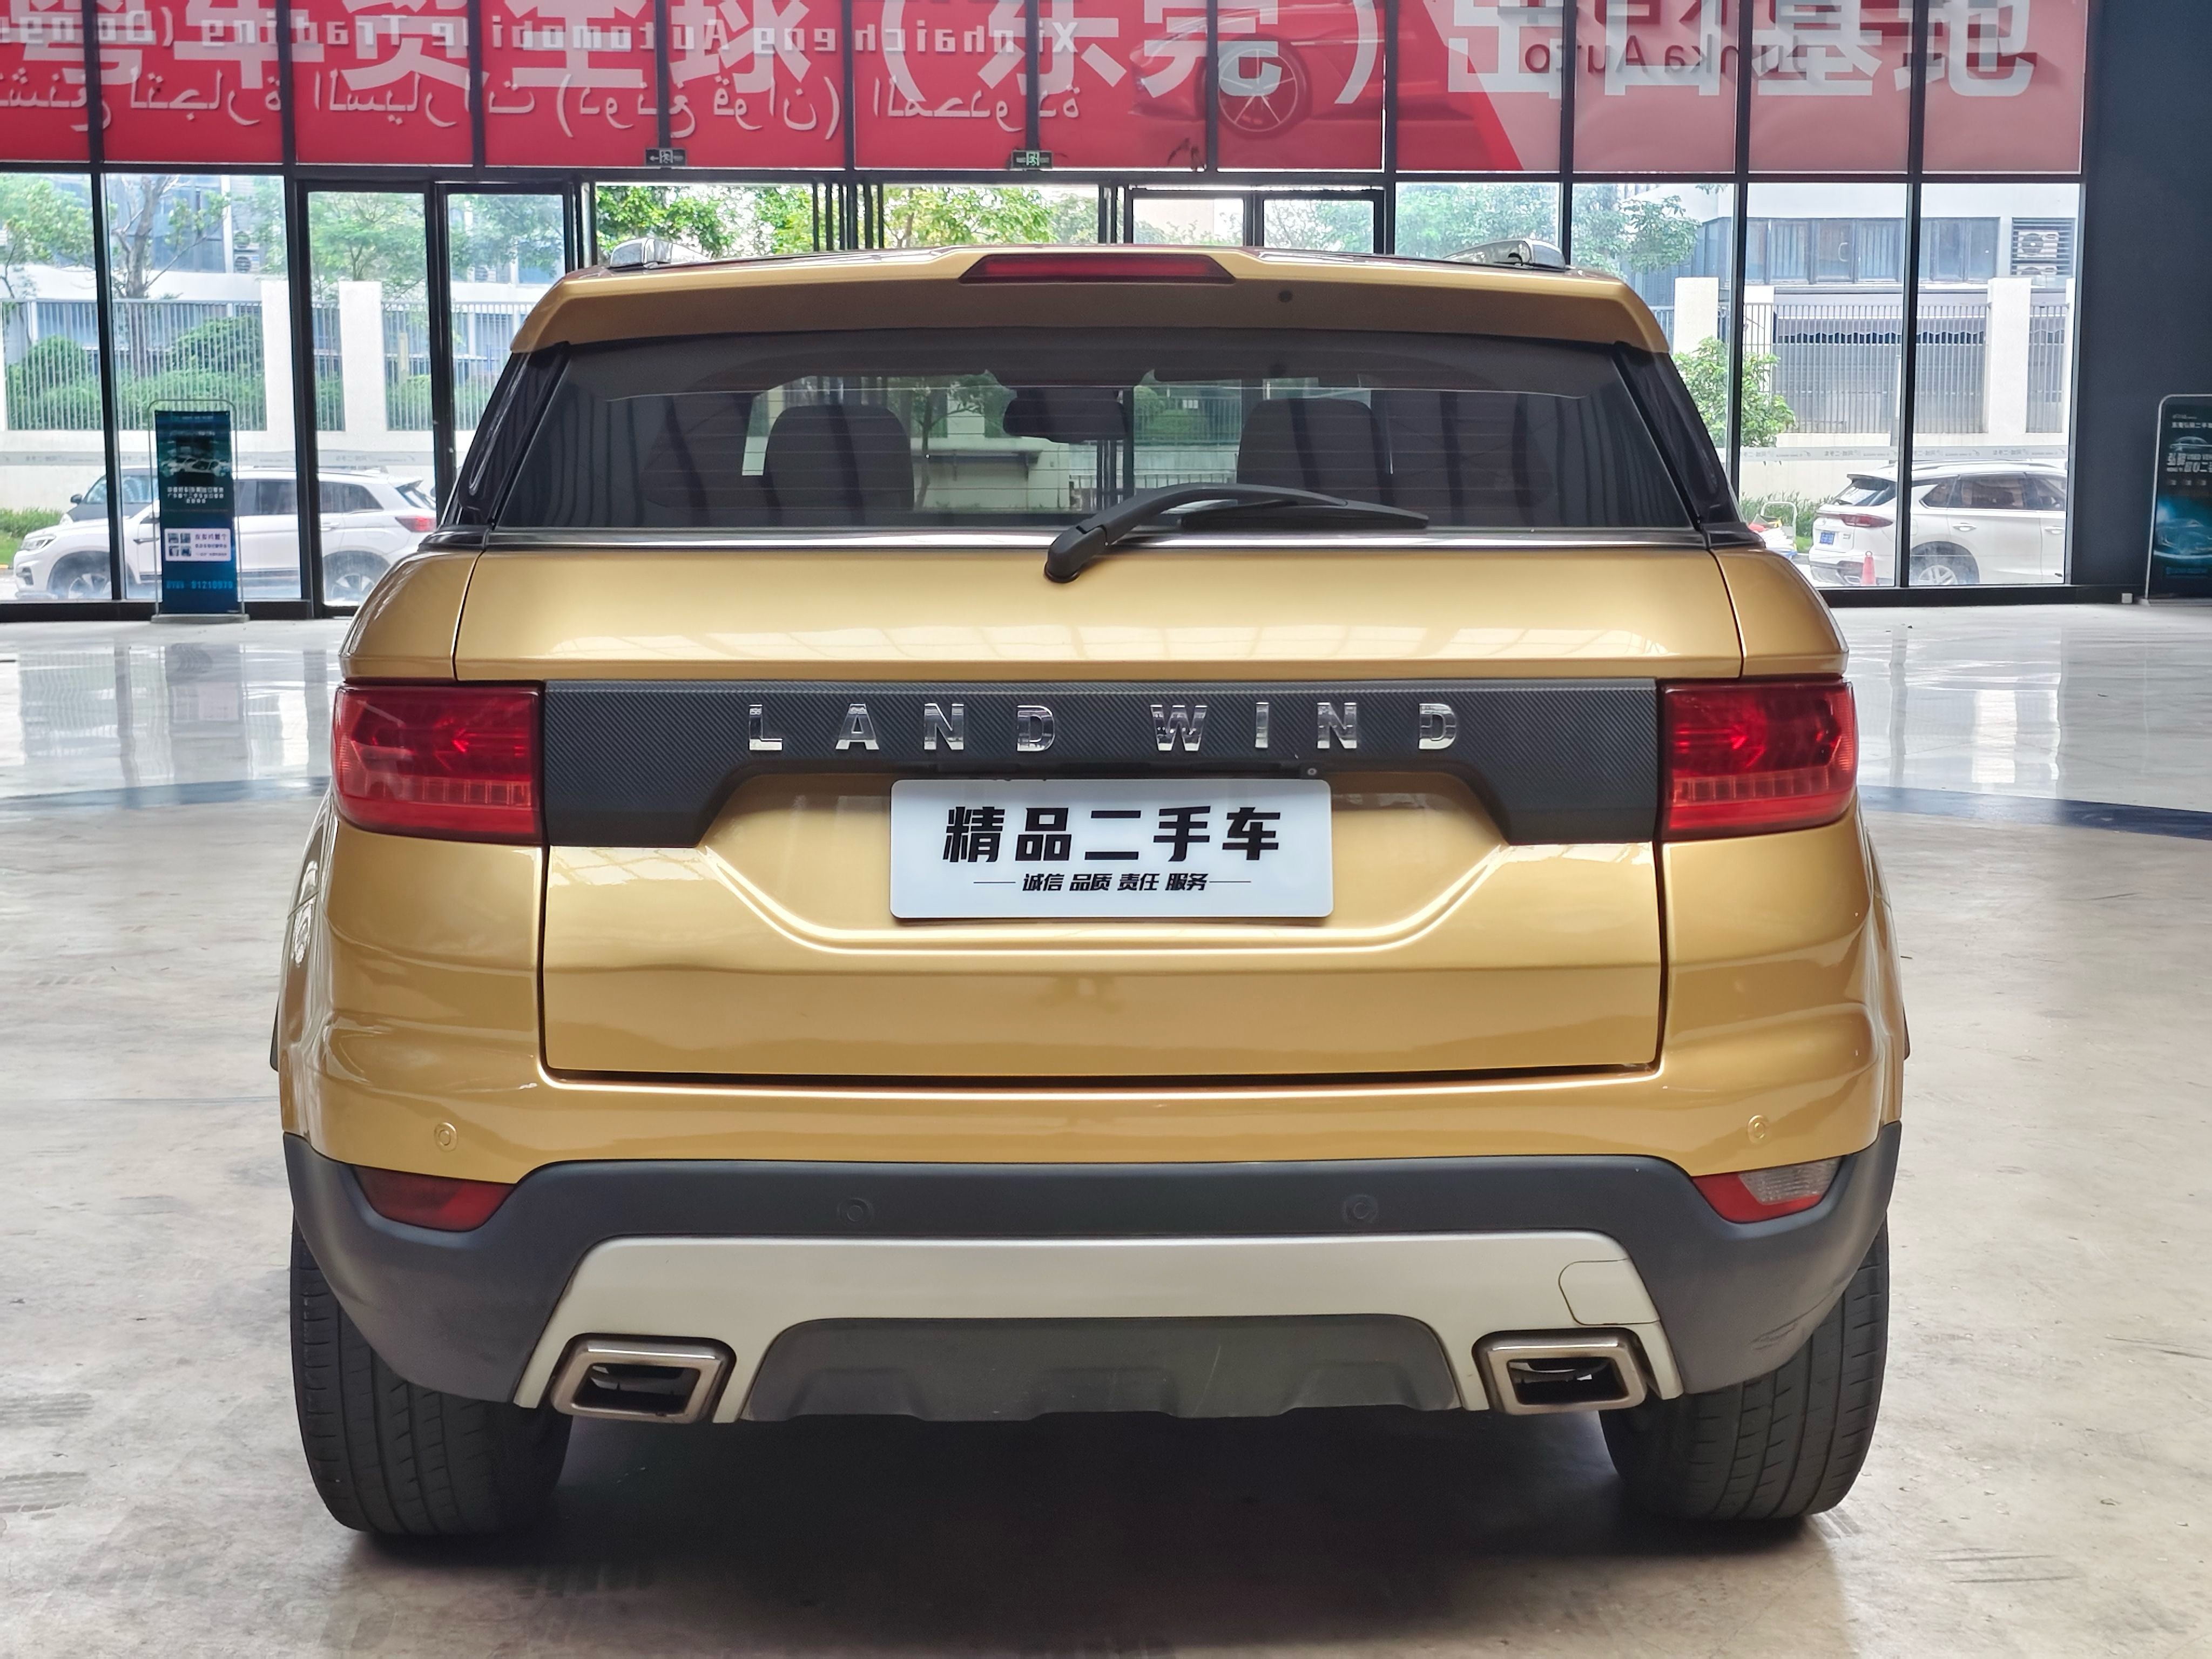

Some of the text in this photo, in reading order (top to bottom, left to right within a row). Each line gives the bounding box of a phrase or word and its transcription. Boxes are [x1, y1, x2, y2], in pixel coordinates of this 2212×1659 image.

[748, 702, 1458, 752] LAND WIND
[942, 806, 1282, 862] 精品二手车
[1022, 873, 1210, 892] 诚信 品质 责任 服务
